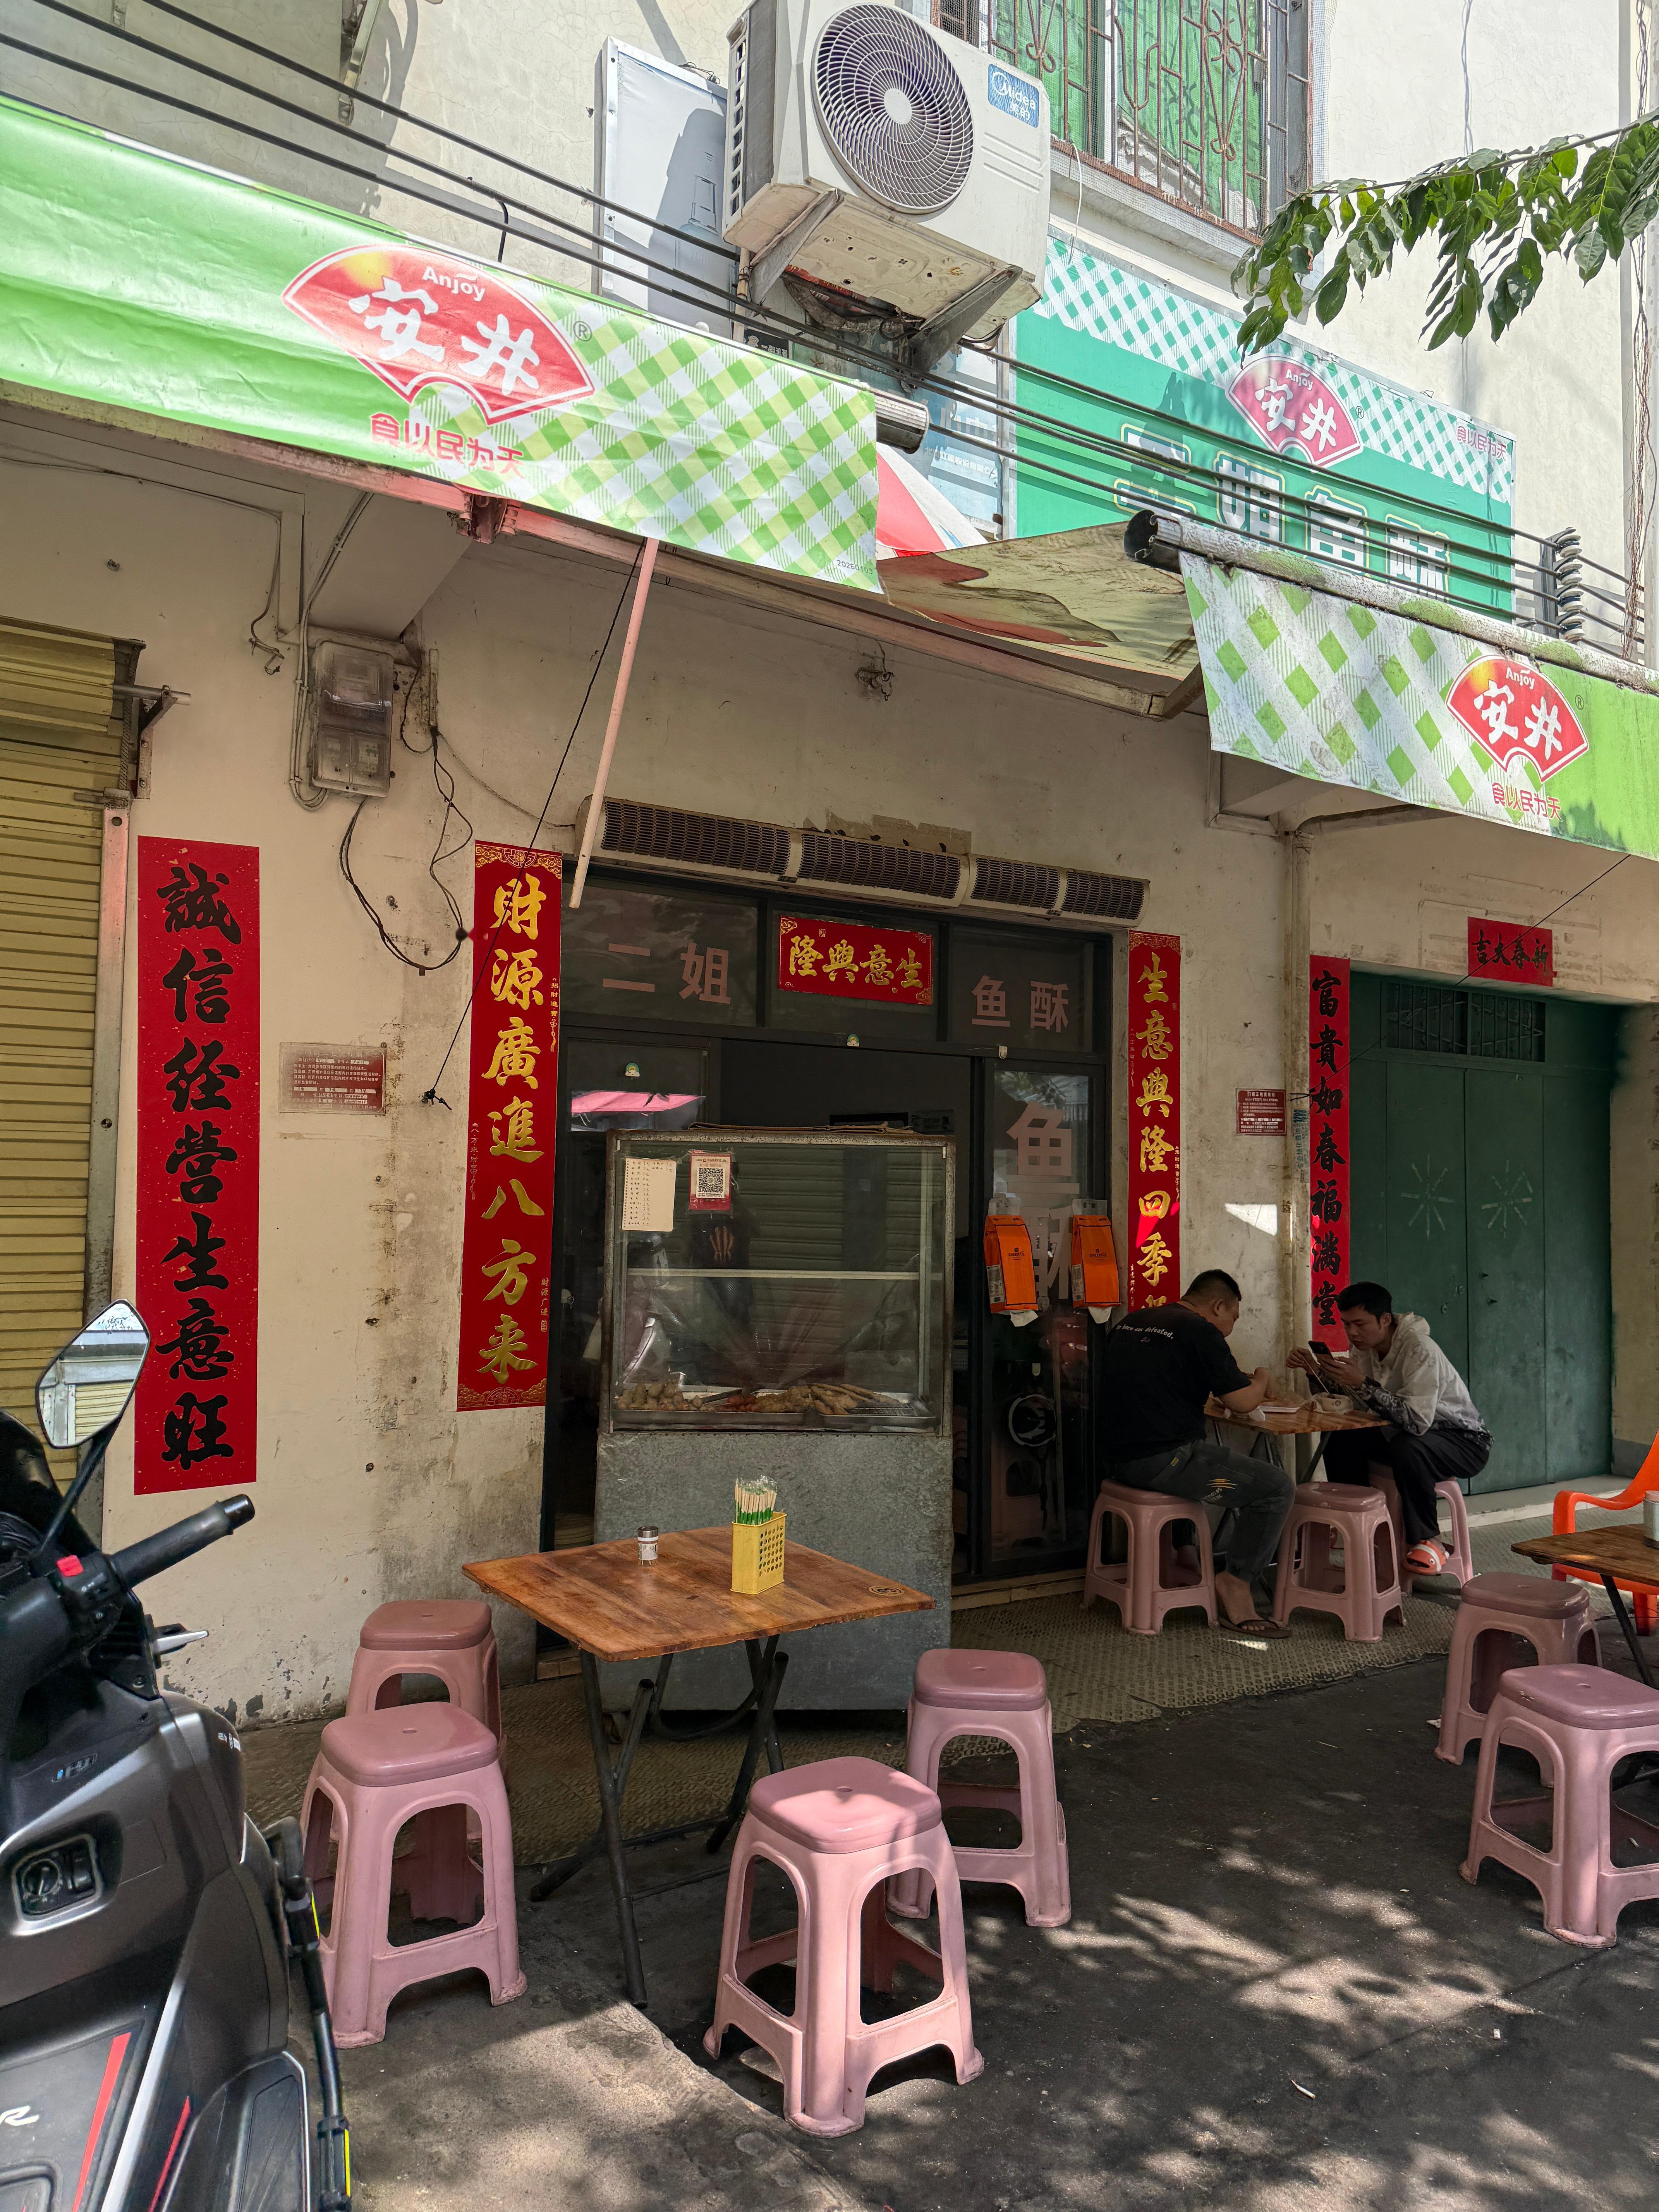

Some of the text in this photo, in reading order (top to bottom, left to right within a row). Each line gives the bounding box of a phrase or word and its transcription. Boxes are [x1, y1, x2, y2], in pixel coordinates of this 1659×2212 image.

[992, 72, 1036, 110] Midea
[1010, 101, 1030, 120] 美的
[422, 266, 486, 302] Anjoy
[348, 276, 540, 395] 安井
[1285, 369, 1313, 391] Anjoy
[1255, 376, 1337, 452] 安井
[370, 412, 525, 479] 食以民为天
[1457, 426, 1506, 461] 食以民为天
[1506, 667, 1535, 689] Anjoy
[1474, 679, 1562, 760] 安井
[1492, 782, 1562, 822] 食以民为天
[603, 941, 1070, 1033] 二姐 鱼酥
